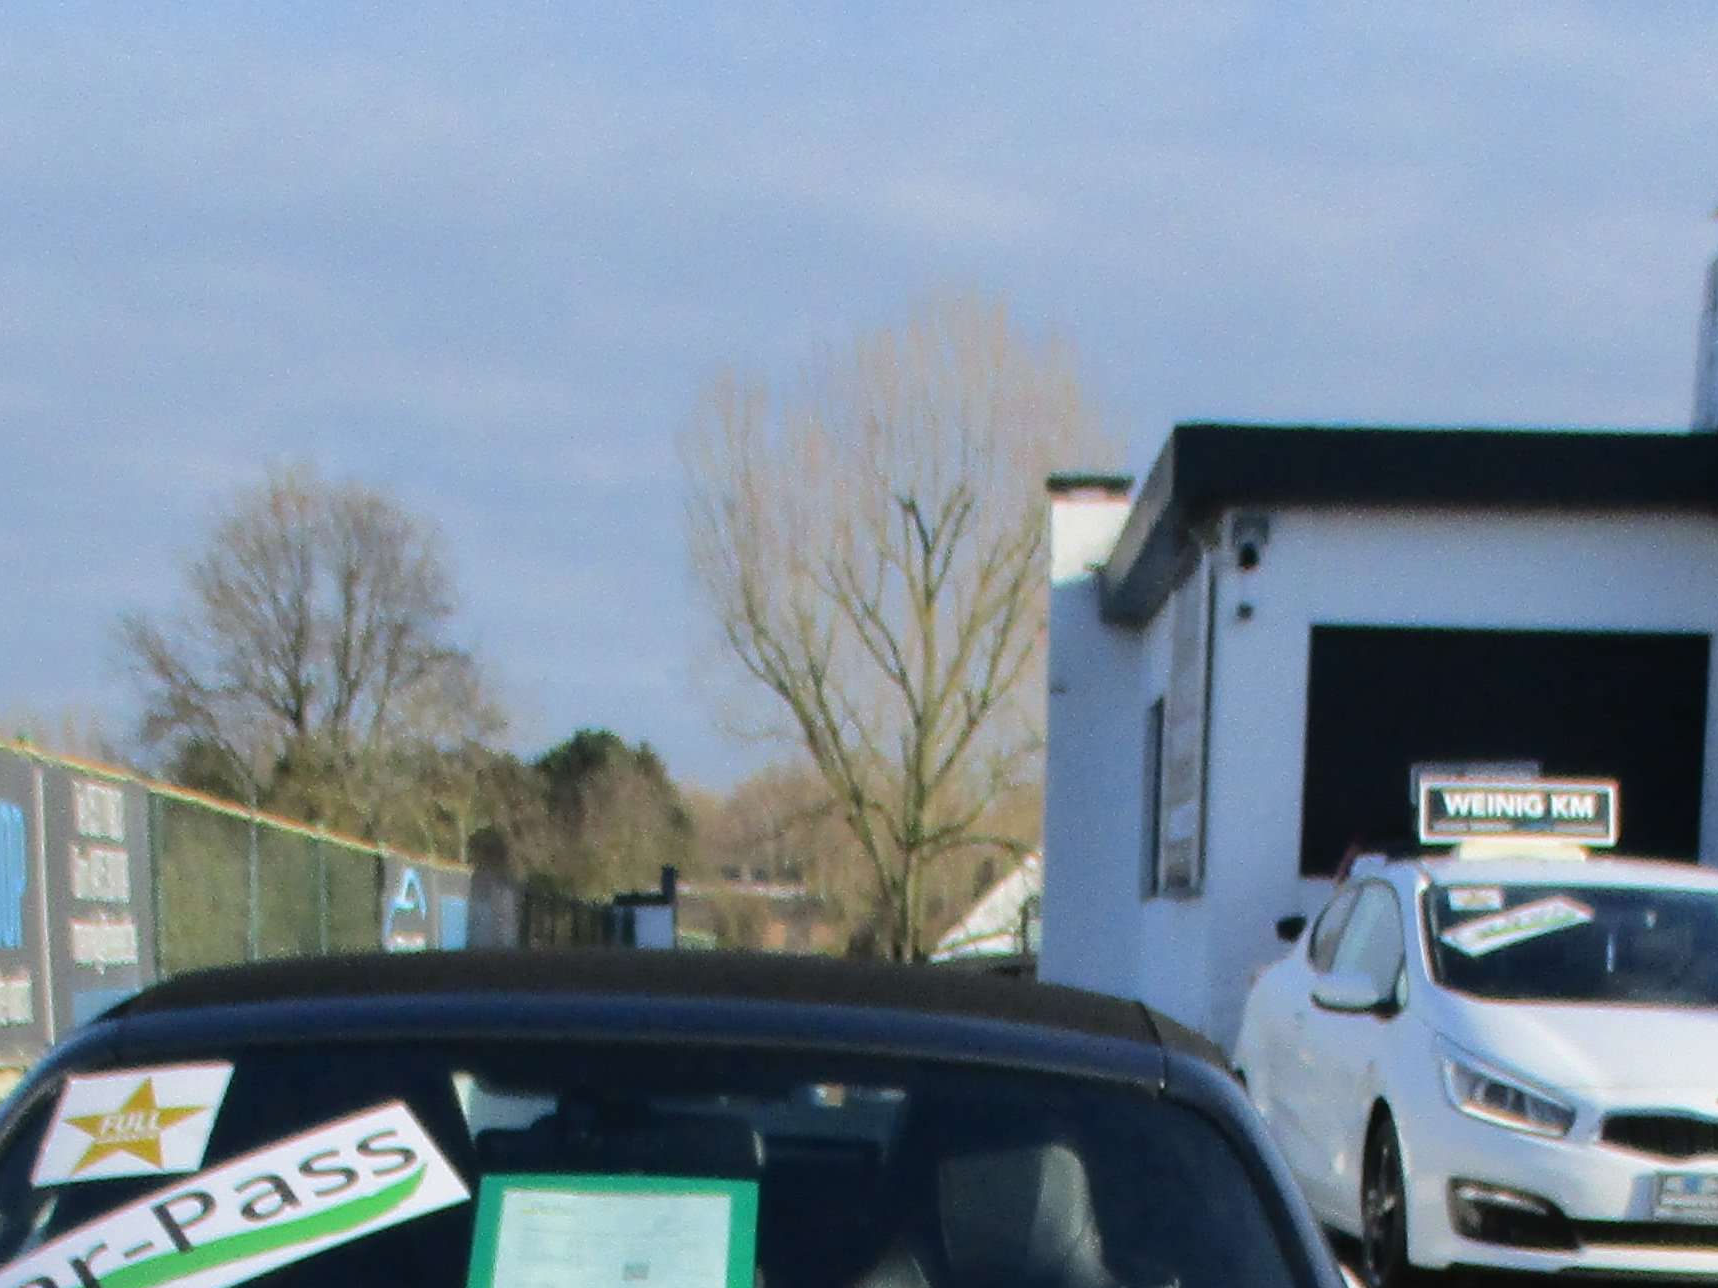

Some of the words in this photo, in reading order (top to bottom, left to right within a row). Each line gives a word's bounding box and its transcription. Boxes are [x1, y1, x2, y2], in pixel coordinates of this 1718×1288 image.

[1442, 791, 1545, 818] WEINIG
[1550, 792, 1598, 819] KM
[100, 1110, 161, 1136] FULL
